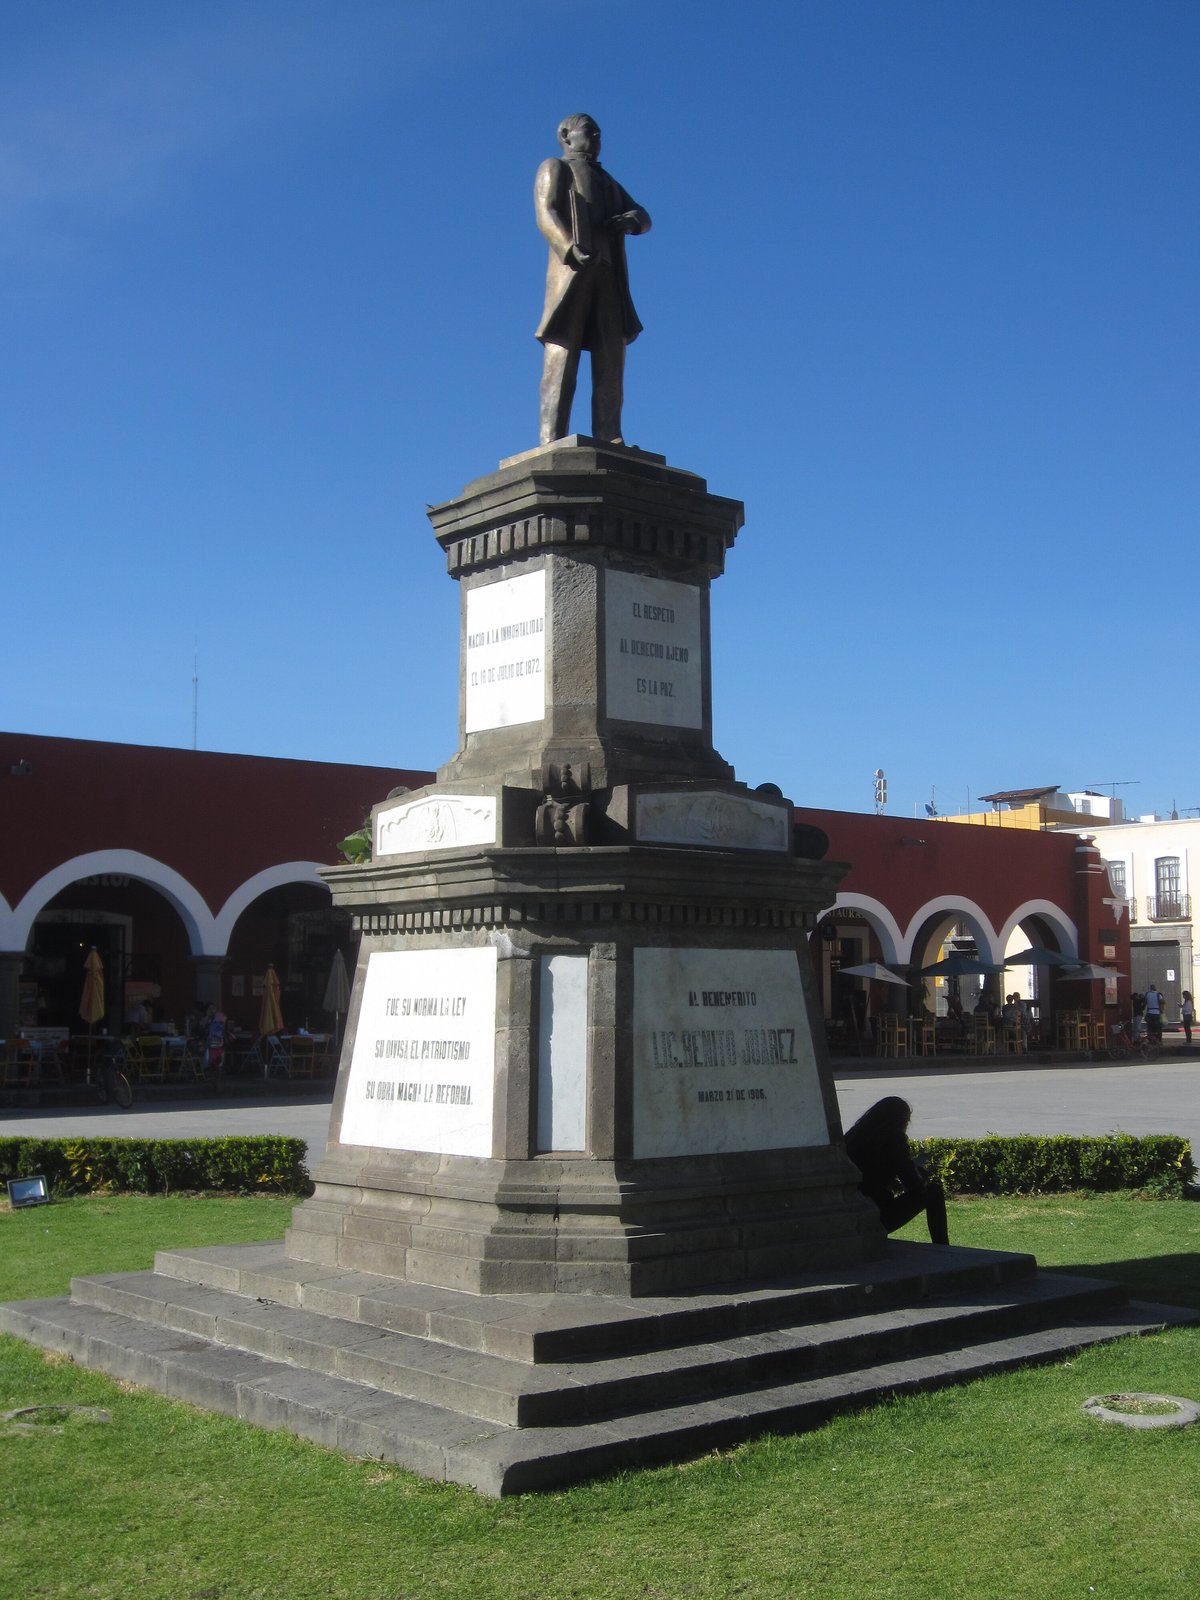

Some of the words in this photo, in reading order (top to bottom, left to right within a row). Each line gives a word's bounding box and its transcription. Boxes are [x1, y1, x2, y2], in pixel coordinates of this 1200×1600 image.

[632, 602, 642, 618] EL
[643, 604, 675, 624] RESPETO
[486, 630, 490, 645] A
[492, 628, 499, 643] LA
[500, 617, 543, 641] INMORTALIDAD
[620, 638, 629, 653] AL
[631, 640, 664, 659] DERECHO
[665, 645, 689, 664] AJENO
[471, 671, 478, 687] EL
[488, 667, 495, 683] DE
[497, 663, 514, 681] JULIO
[516, 661, 524, 677] DE
[636, 678, 647, 694] ES
[649, 679, 658, 695] LA
[386, 998, 400, 1016] FUE
[402, 998, 411, 1016] SU
[413, 997, 438, 1016] NORMA
[440, 997, 449, 1016] LA
[451, 997, 467, 1016] LEY
[688, 991, 700, 1007] AL
[702, 991, 757, 1007] BENEMERITO
[375, 1040, 385, 1058] SU
[386, 1040, 408, 1059] DIVISA
[410, 1040, 419, 1059] EL
[421, 1040, 471, 1060] PATRIOTISMO
[366, 1081, 376, 1099] SU
[377, 1081, 395, 1101] OBRA
[397, 1082, 421, 1102] MAGNA
[423, 1083, 434, 1103] LA
[698, 1091, 724, 1103] MARZO
[735, 1089, 746, 1101] DE
